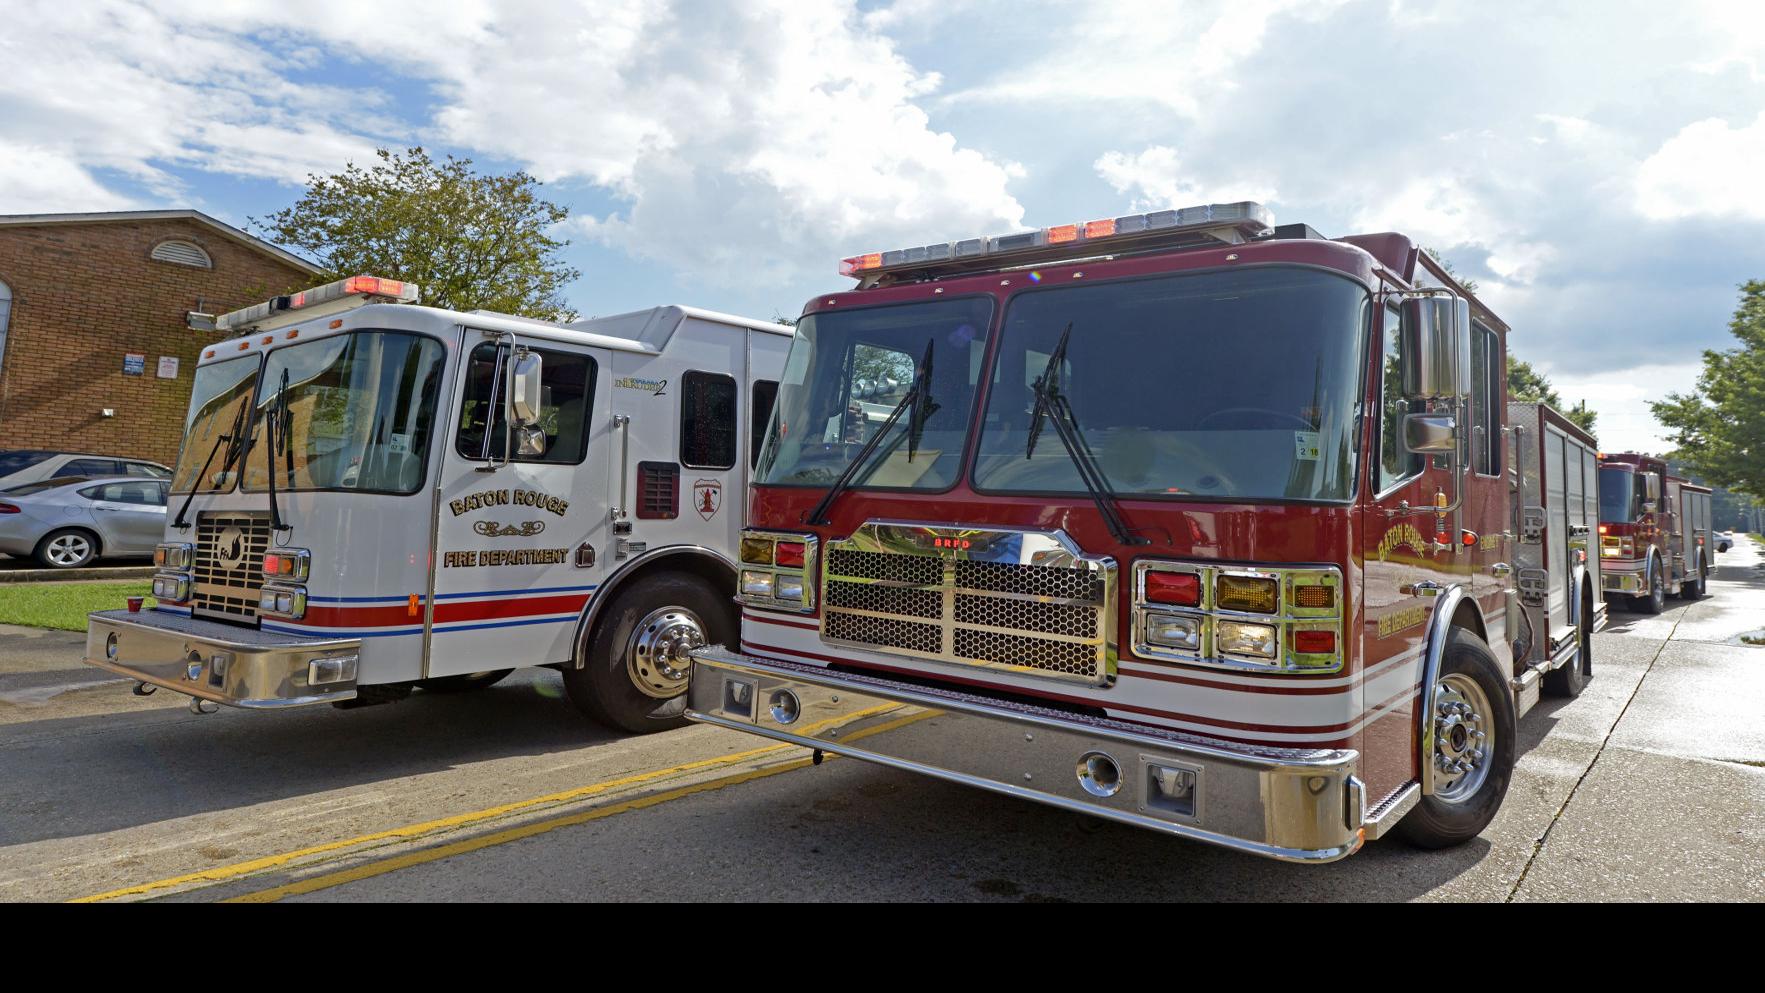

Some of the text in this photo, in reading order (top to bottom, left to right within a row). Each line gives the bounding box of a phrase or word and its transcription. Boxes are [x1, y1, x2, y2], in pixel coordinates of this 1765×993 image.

[449, 489, 569, 516] BATON ROUGE
[934, 537, 970, 549] BRFD
[1378, 522, 1403, 562] BATON
[444, 548, 569, 568] FIRE DEPARTMENT
[1378, 613, 1392, 638] FIRE
